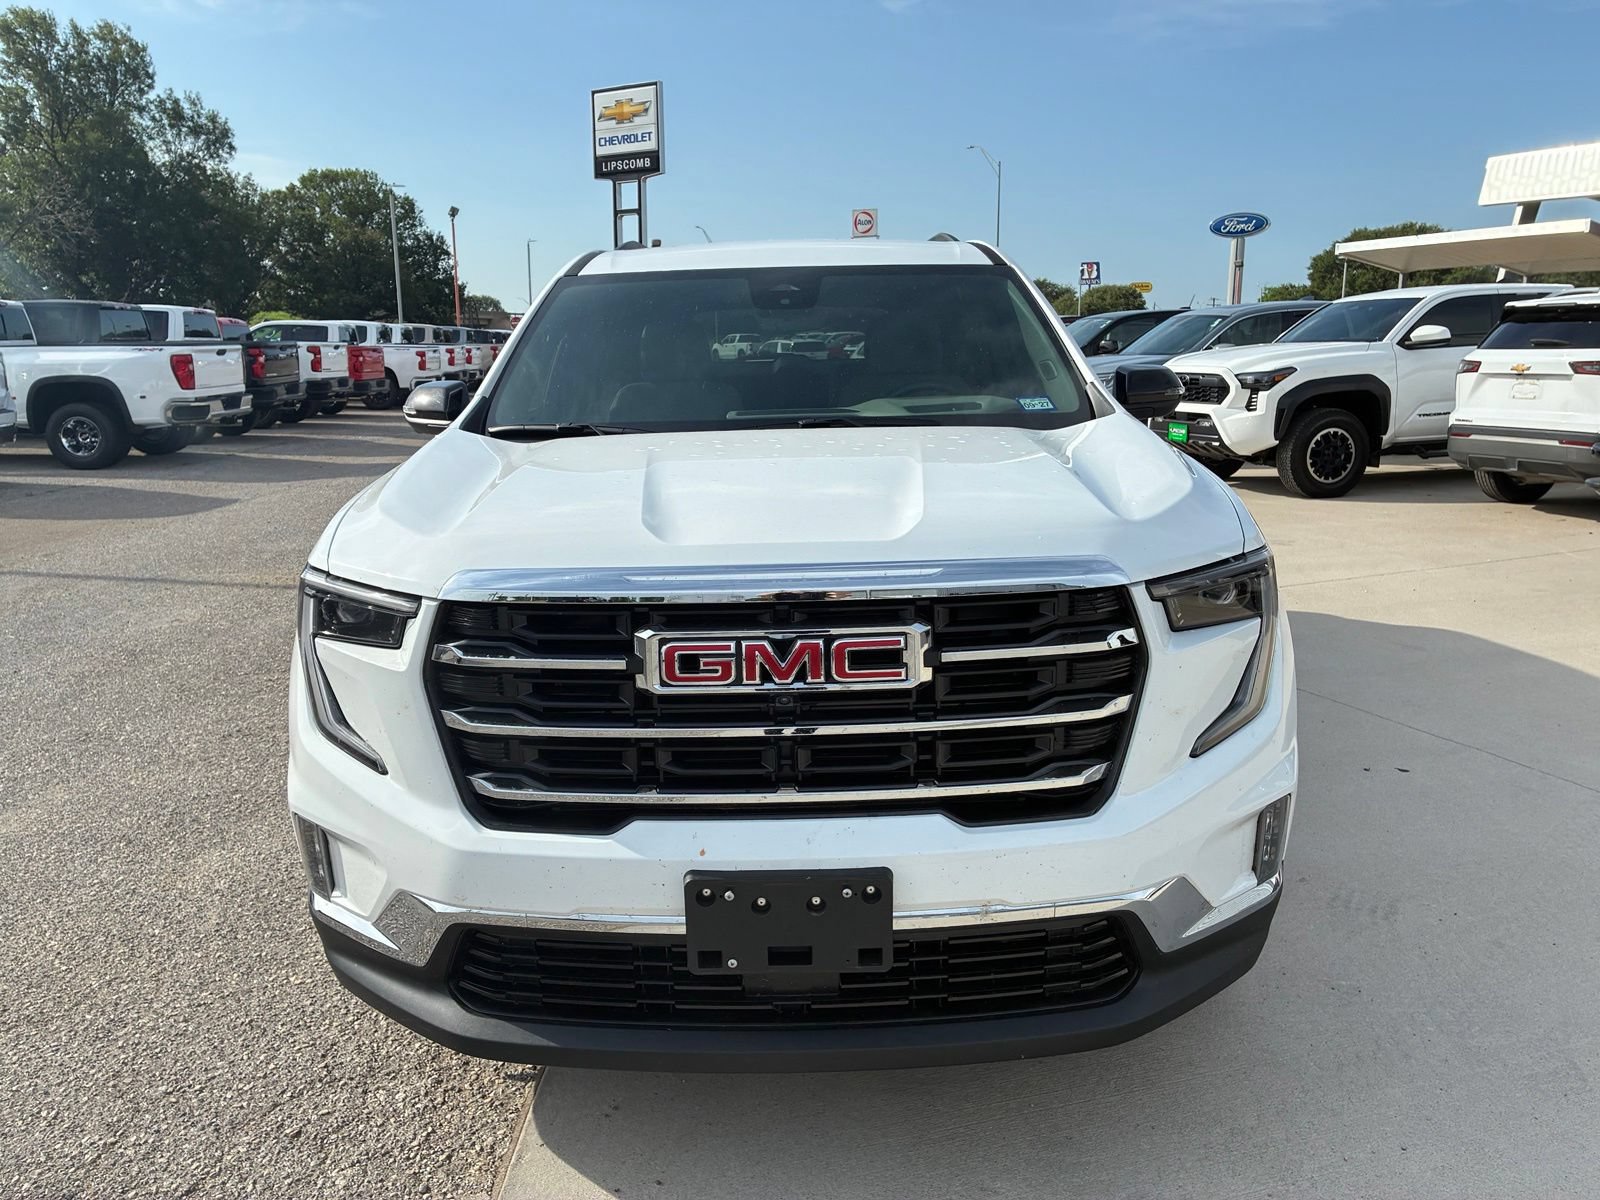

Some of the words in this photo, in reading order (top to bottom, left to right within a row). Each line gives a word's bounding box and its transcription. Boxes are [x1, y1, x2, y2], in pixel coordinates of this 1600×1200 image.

[598, 132, 653, 147] CHEVROLET
[602, 158, 651, 171] LIPSCOMB
[1221, 217, 1256, 233] Ford
[661, 635, 908, 686] GMC
